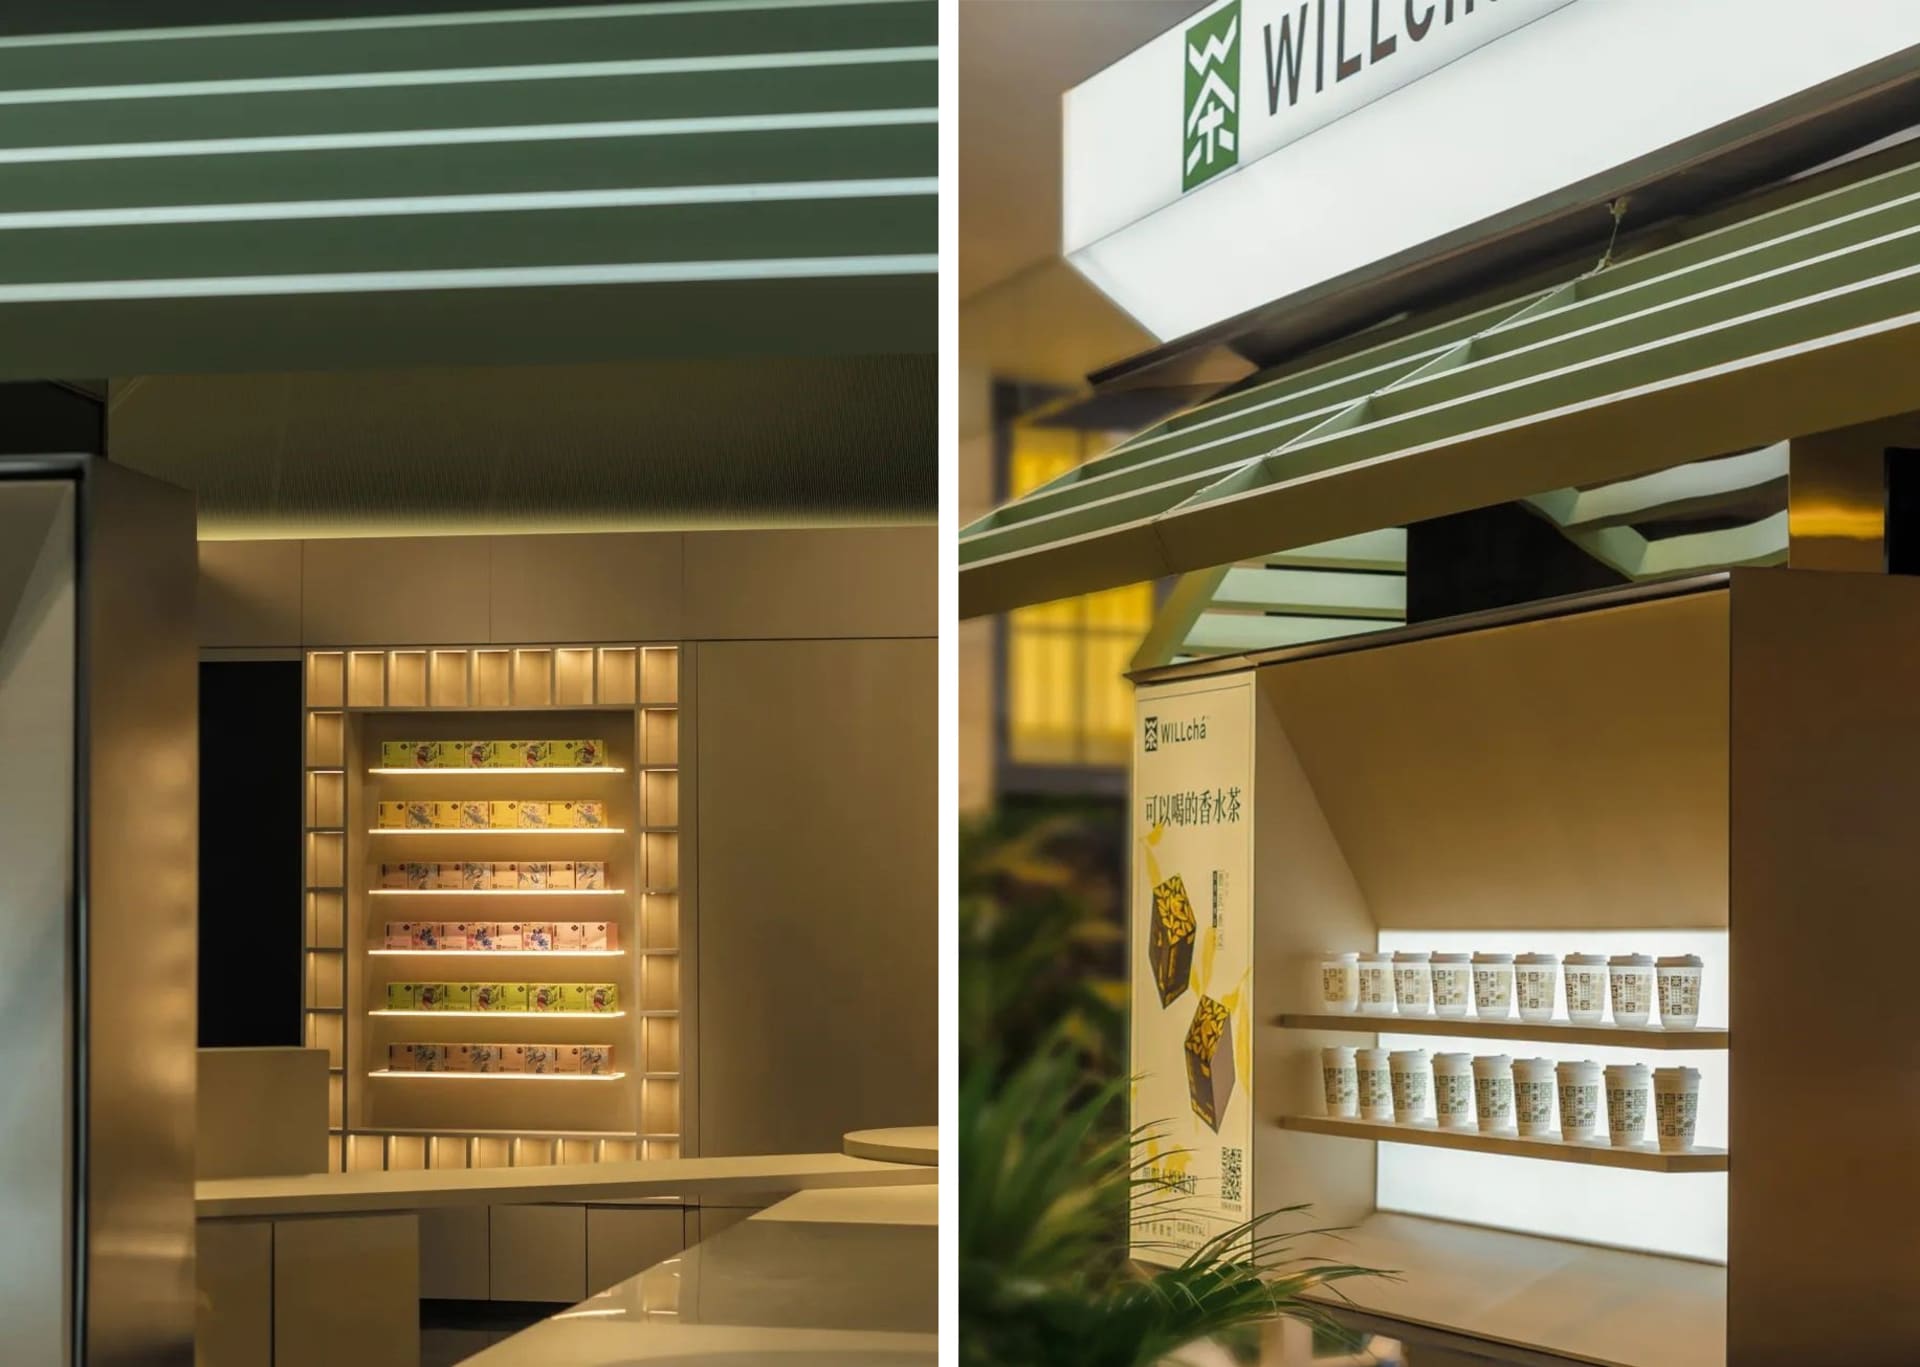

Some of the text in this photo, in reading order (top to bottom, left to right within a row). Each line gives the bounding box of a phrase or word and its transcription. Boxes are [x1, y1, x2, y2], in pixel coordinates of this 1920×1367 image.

[1161, 715, 1207, 743] WILLchá
[1145, 787, 1241, 828] 可以喝的香水茶
